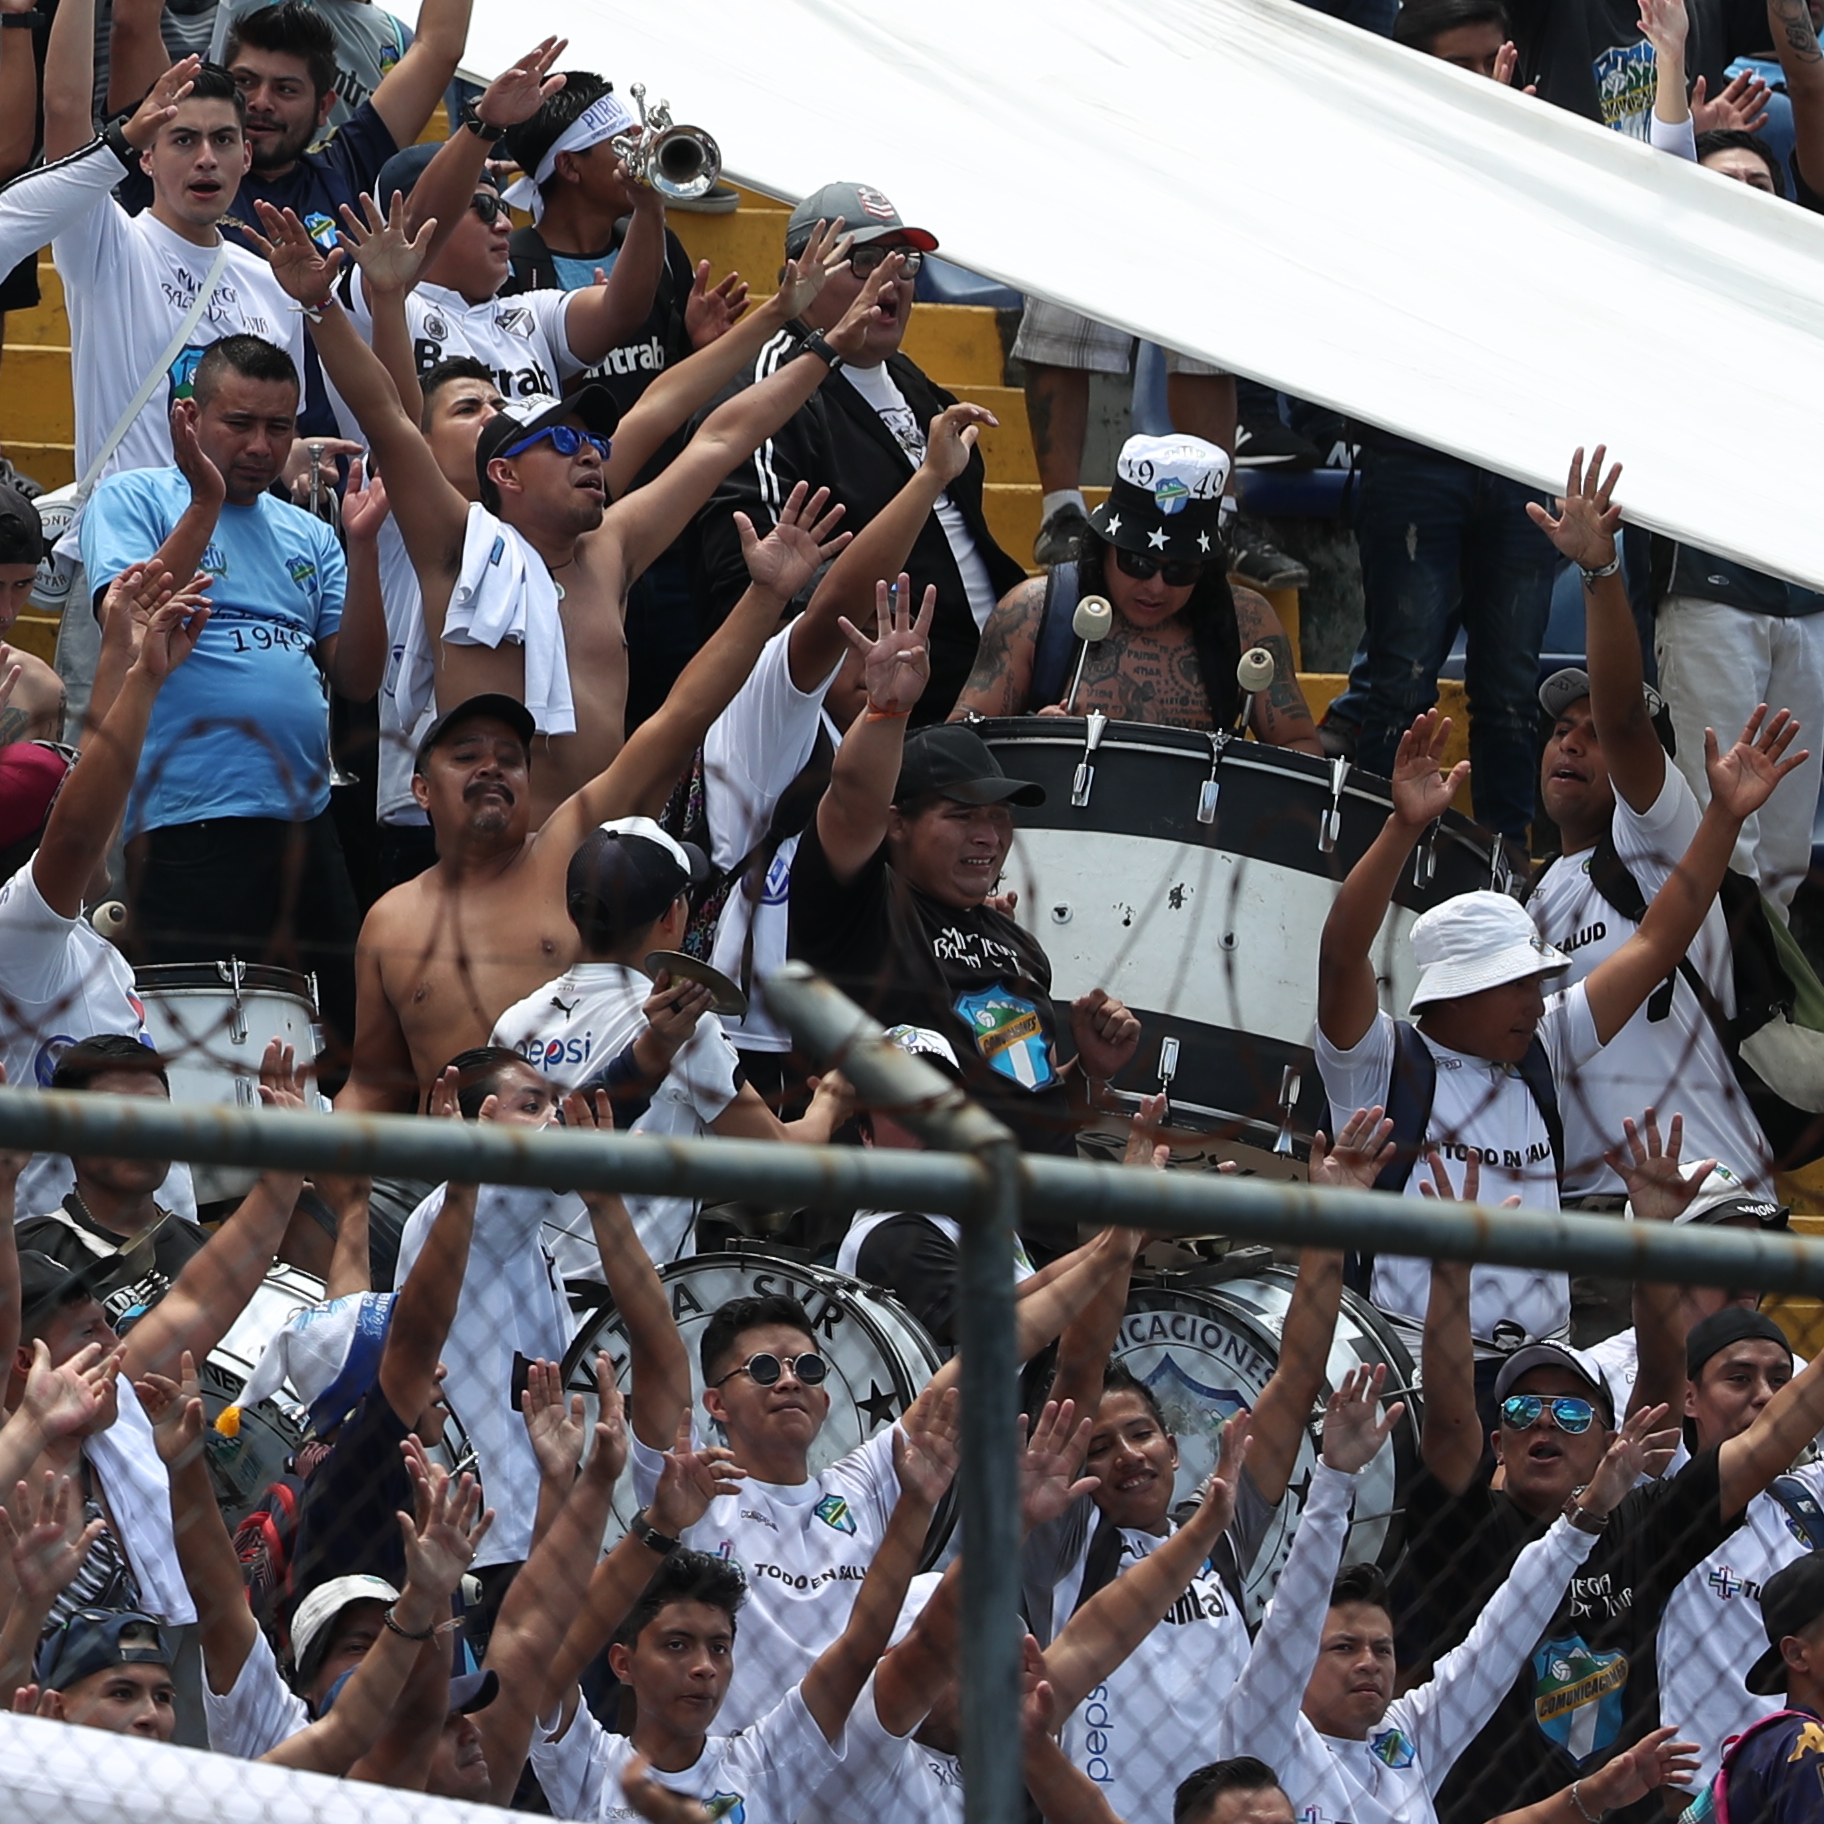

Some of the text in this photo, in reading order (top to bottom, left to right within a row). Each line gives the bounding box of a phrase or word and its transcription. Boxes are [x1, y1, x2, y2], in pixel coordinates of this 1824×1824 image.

[582, 95, 624, 130] PURO
[415, 337, 553, 399] Btrab
[583, 334, 666, 380] ntrab
[36, 571, 68, 588] STAR
[228, 624, 309, 654] 1949
[1554, 921, 1608, 955] SALUD
[514, 1030, 592, 1072] pepsi
[1503, 1147, 1522, 1168] EN
[104, 1286, 140, 1317] LOS
[753, 1271, 847, 1337] SVR
[754, 1562, 808, 1590] TODO
[810, 1568, 837, 1590] EN
[1539, 1657, 1629, 1718] COMUNICACIONES
[1087, 1684, 1115, 1783] peps
